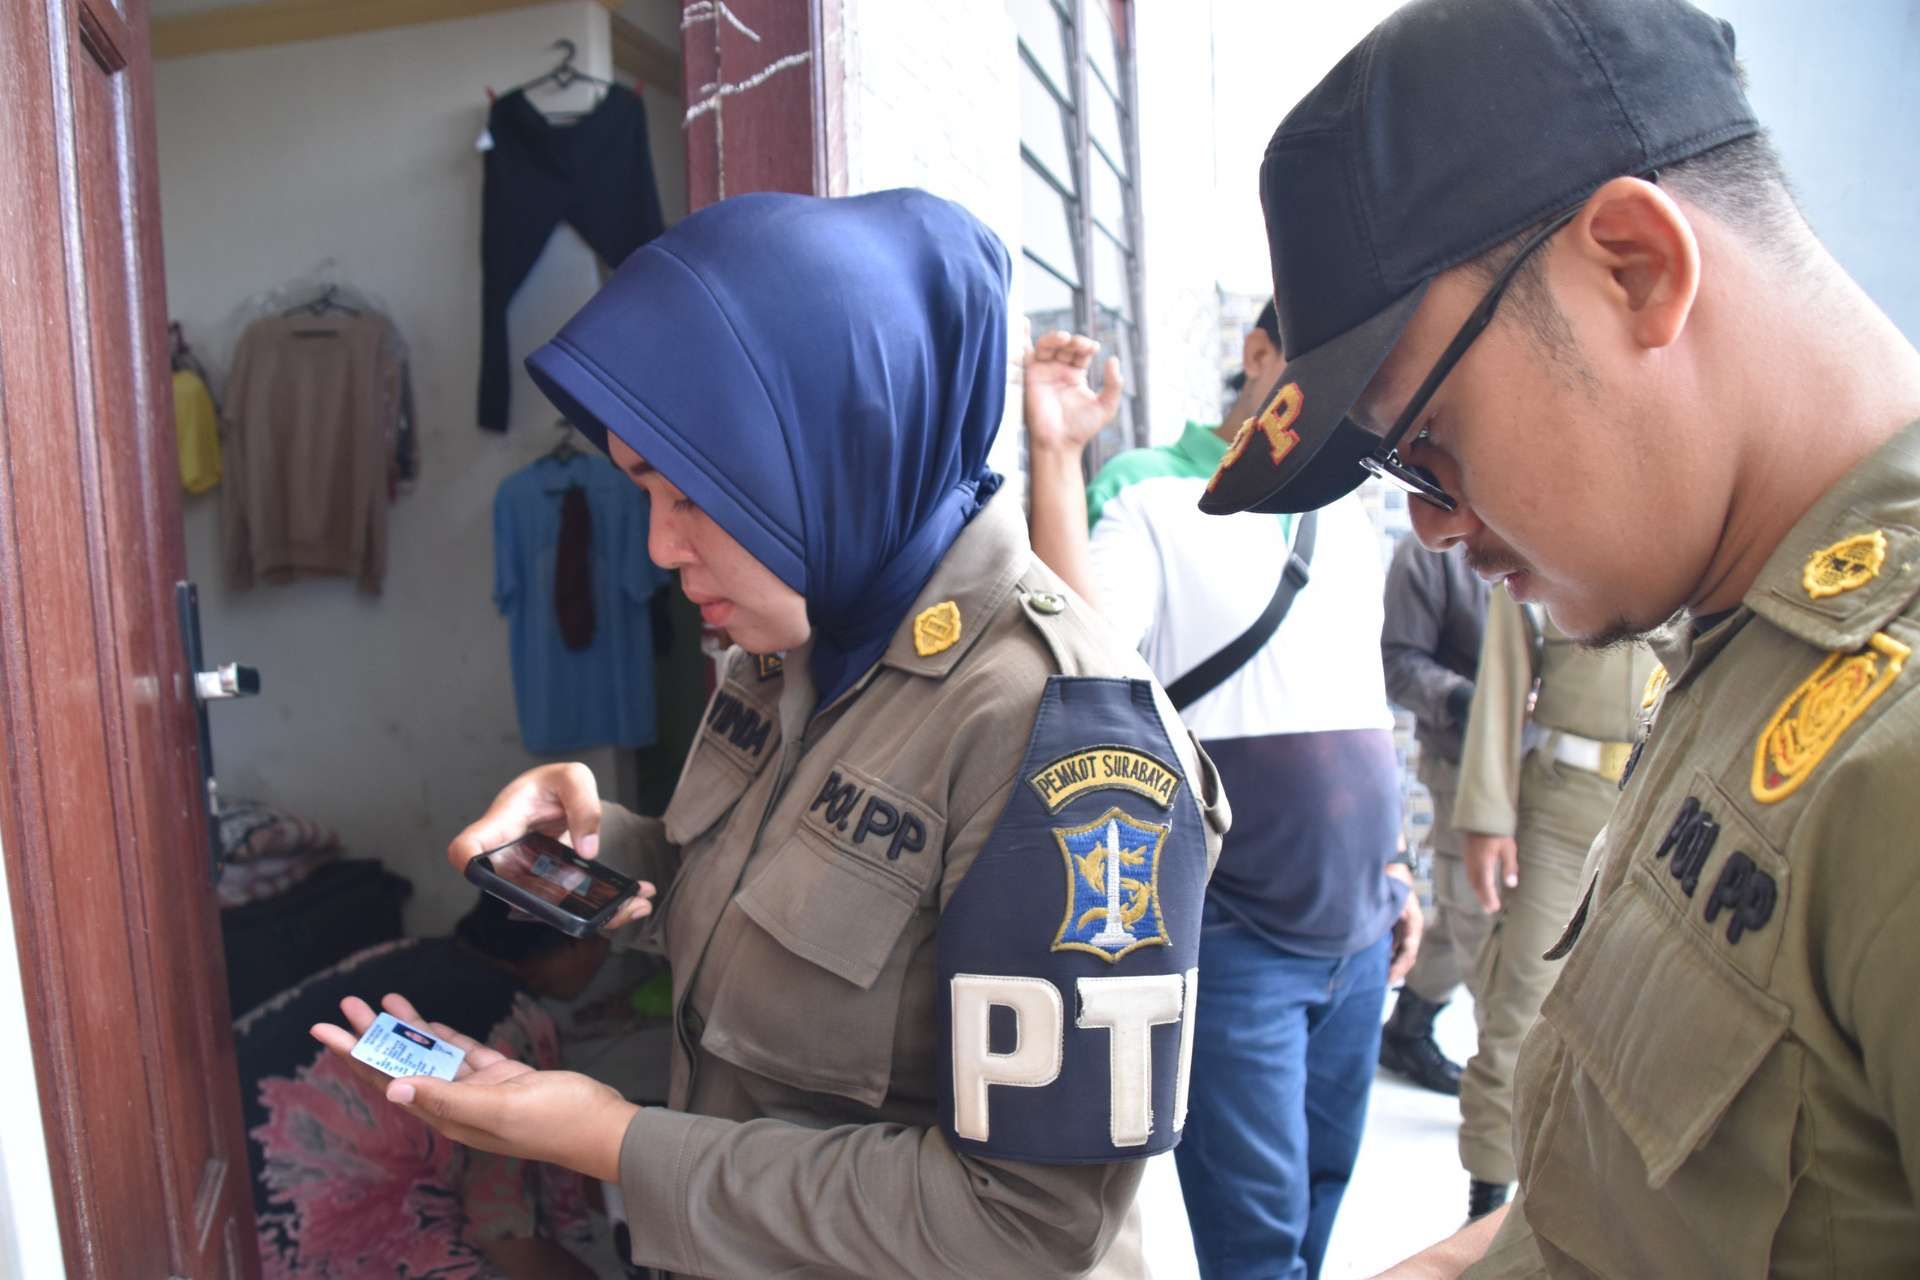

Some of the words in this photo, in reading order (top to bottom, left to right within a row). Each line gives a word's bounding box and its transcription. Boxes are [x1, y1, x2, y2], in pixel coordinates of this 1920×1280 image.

[1036, 755, 1097, 800] PEMKOT
[1102, 754, 1173, 798] SURABAYA
[853, 795, 927, 861] PP
[1704, 850, 1778, 945] PP
